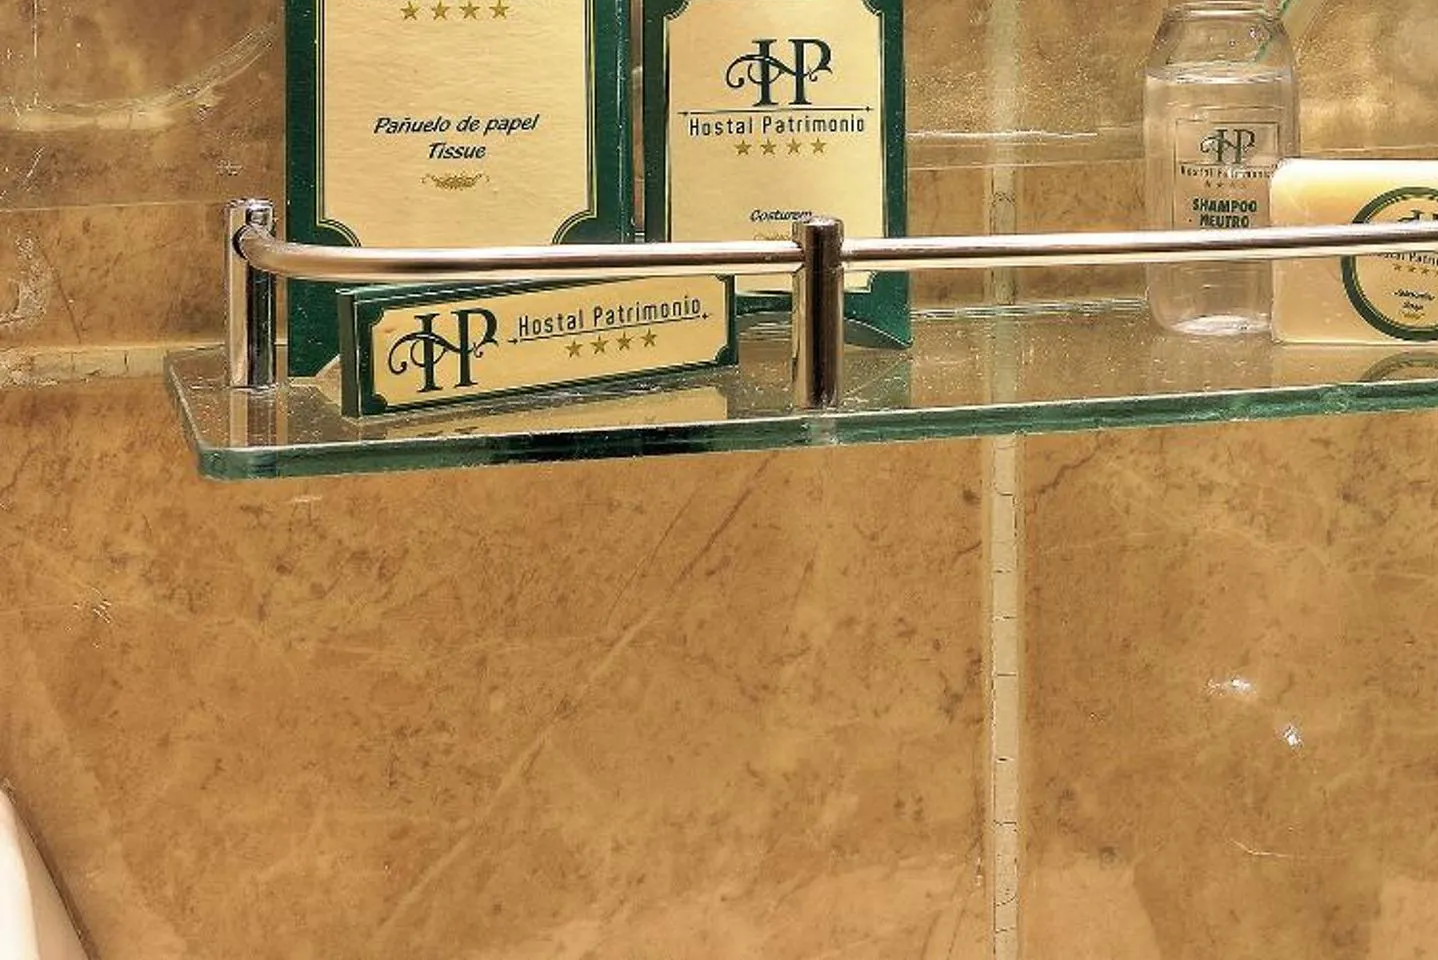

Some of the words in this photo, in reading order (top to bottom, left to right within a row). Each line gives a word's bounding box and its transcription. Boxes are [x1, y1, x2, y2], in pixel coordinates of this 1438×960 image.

[373, 115, 451, 135] Pañuelo
[455, 114, 481, 133] de
[483, 113, 541, 137] papel
[689, 116, 753, 136] Hostal
[762, 113, 865, 135] Patrimonio
[428, 141, 487, 160] Tissue
[1192, 198, 1258, 213] SHAMPOO
[1199, 214, 1250, 228] NEUTRO
[517, 308, 585, 338] Hostal
[593, 293, 701, 328] Patrimonio
